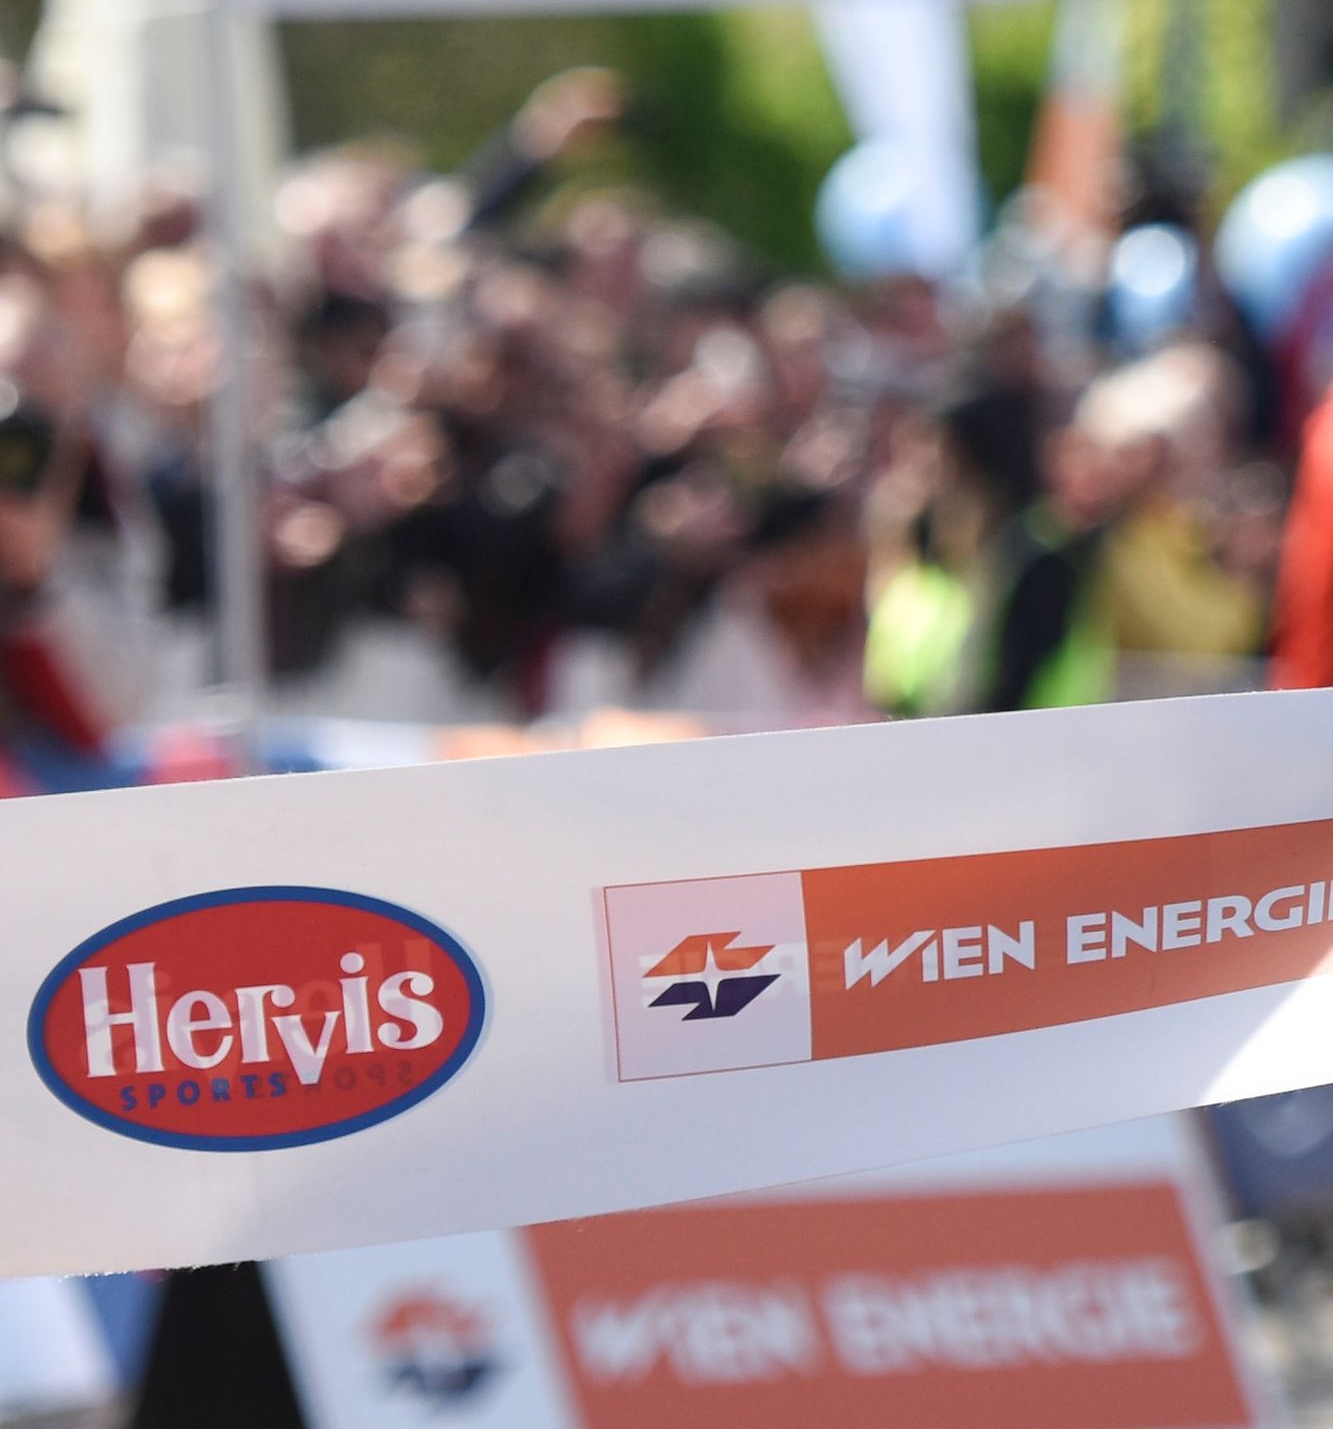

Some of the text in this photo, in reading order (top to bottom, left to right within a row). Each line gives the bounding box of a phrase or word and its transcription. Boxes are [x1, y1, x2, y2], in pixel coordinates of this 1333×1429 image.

[842, 921, 1036, 992] WIEN
[79, 952, 444, 1086] Hervis
[120, 1074, 289, 1113] SPORTS
